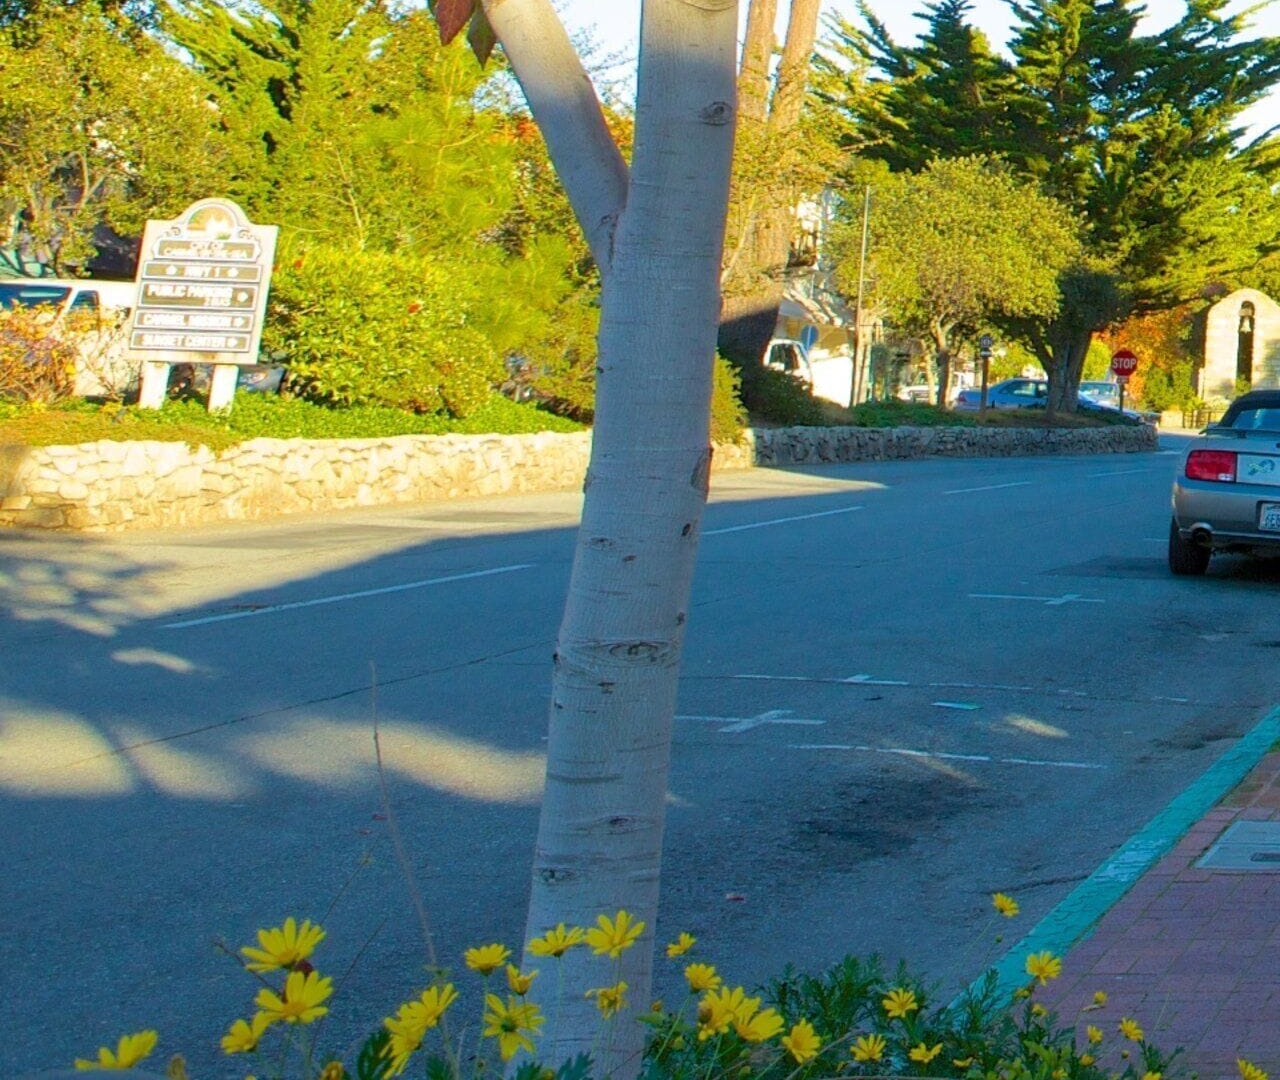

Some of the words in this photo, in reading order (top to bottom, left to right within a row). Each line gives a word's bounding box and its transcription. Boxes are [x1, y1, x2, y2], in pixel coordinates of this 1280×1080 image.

[147, 283, 187, 297] PUBLIC
[187, 285, 233, 299] PARKING
[183, 335, 227, 349] CENTER
[1113, 357, 1137, 369] STOP
